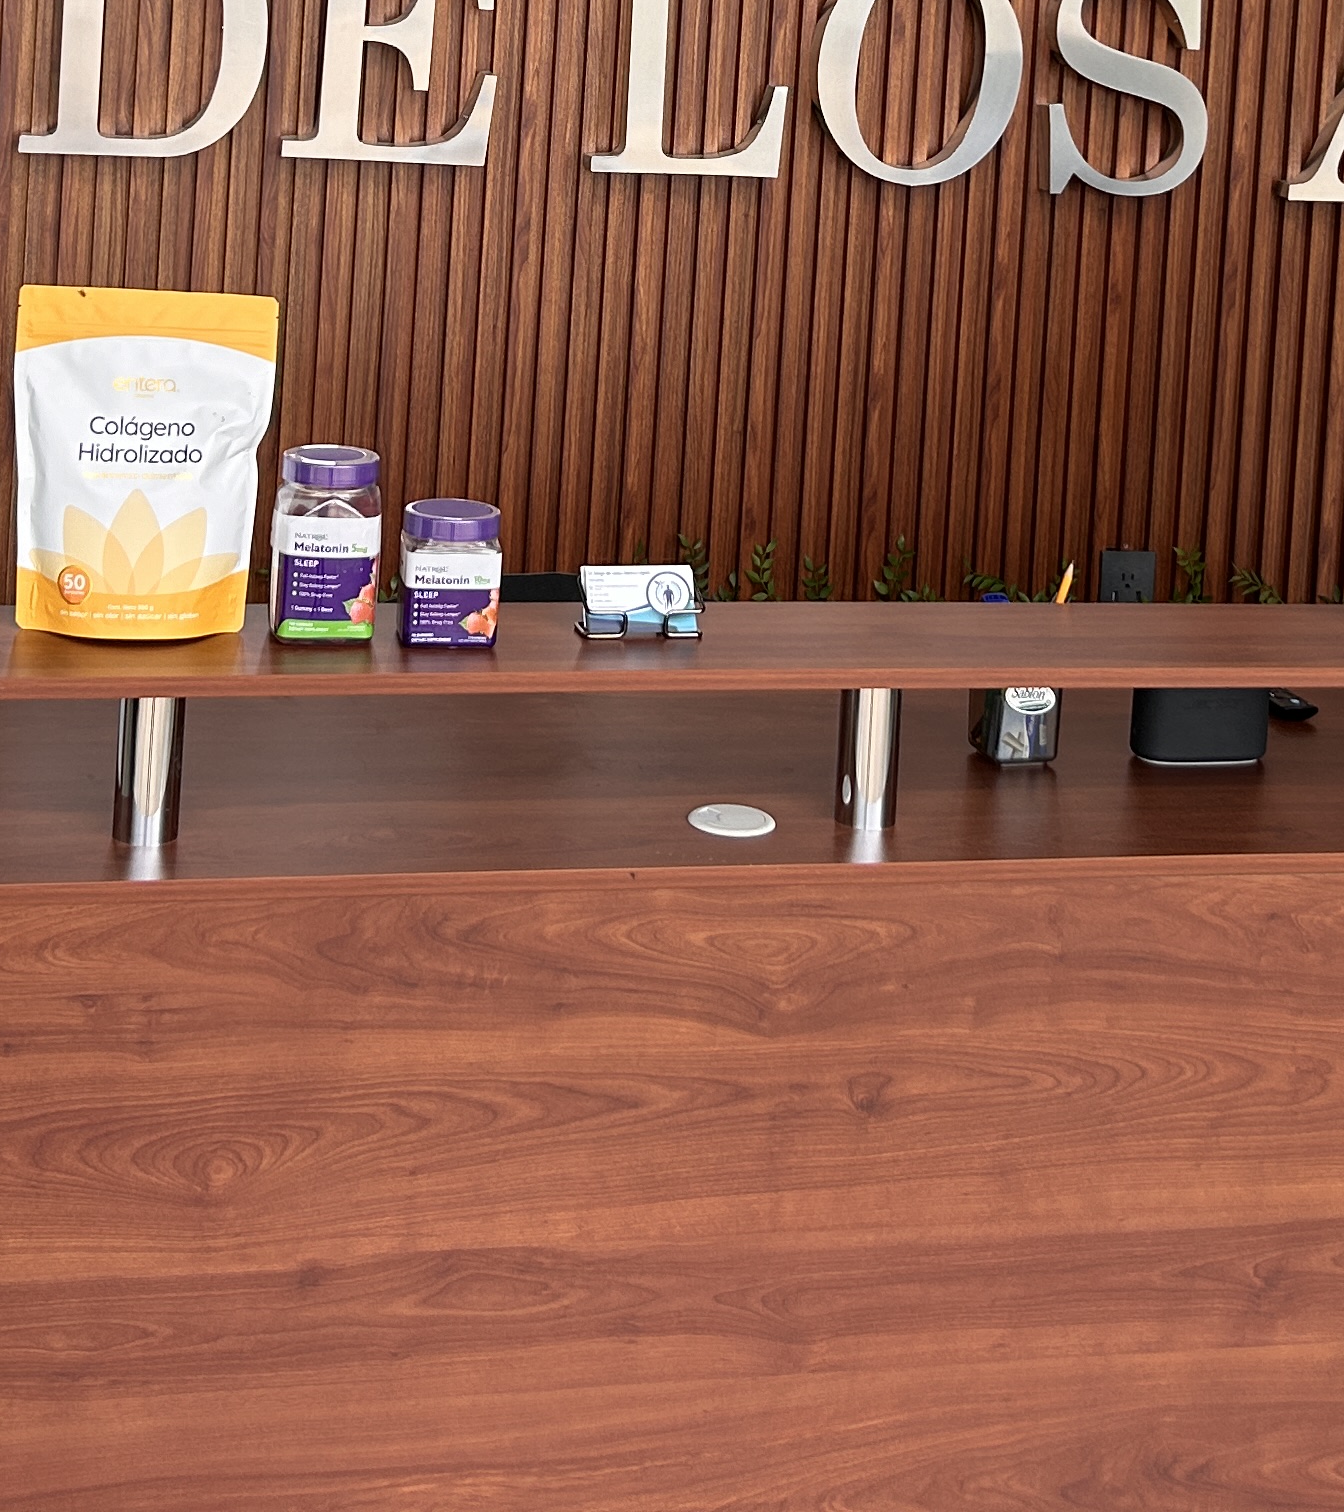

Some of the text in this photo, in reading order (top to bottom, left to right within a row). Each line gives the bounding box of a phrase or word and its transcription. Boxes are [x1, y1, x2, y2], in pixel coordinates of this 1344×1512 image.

[89, 415, 196, 441] Colágeno
[78, 442, 204, 464] Hidrolizado
[294, 541, 350, 554] Melatonin
[63, 573, 86, 590] 50
[414, 574, 471, 585] Melatonin
